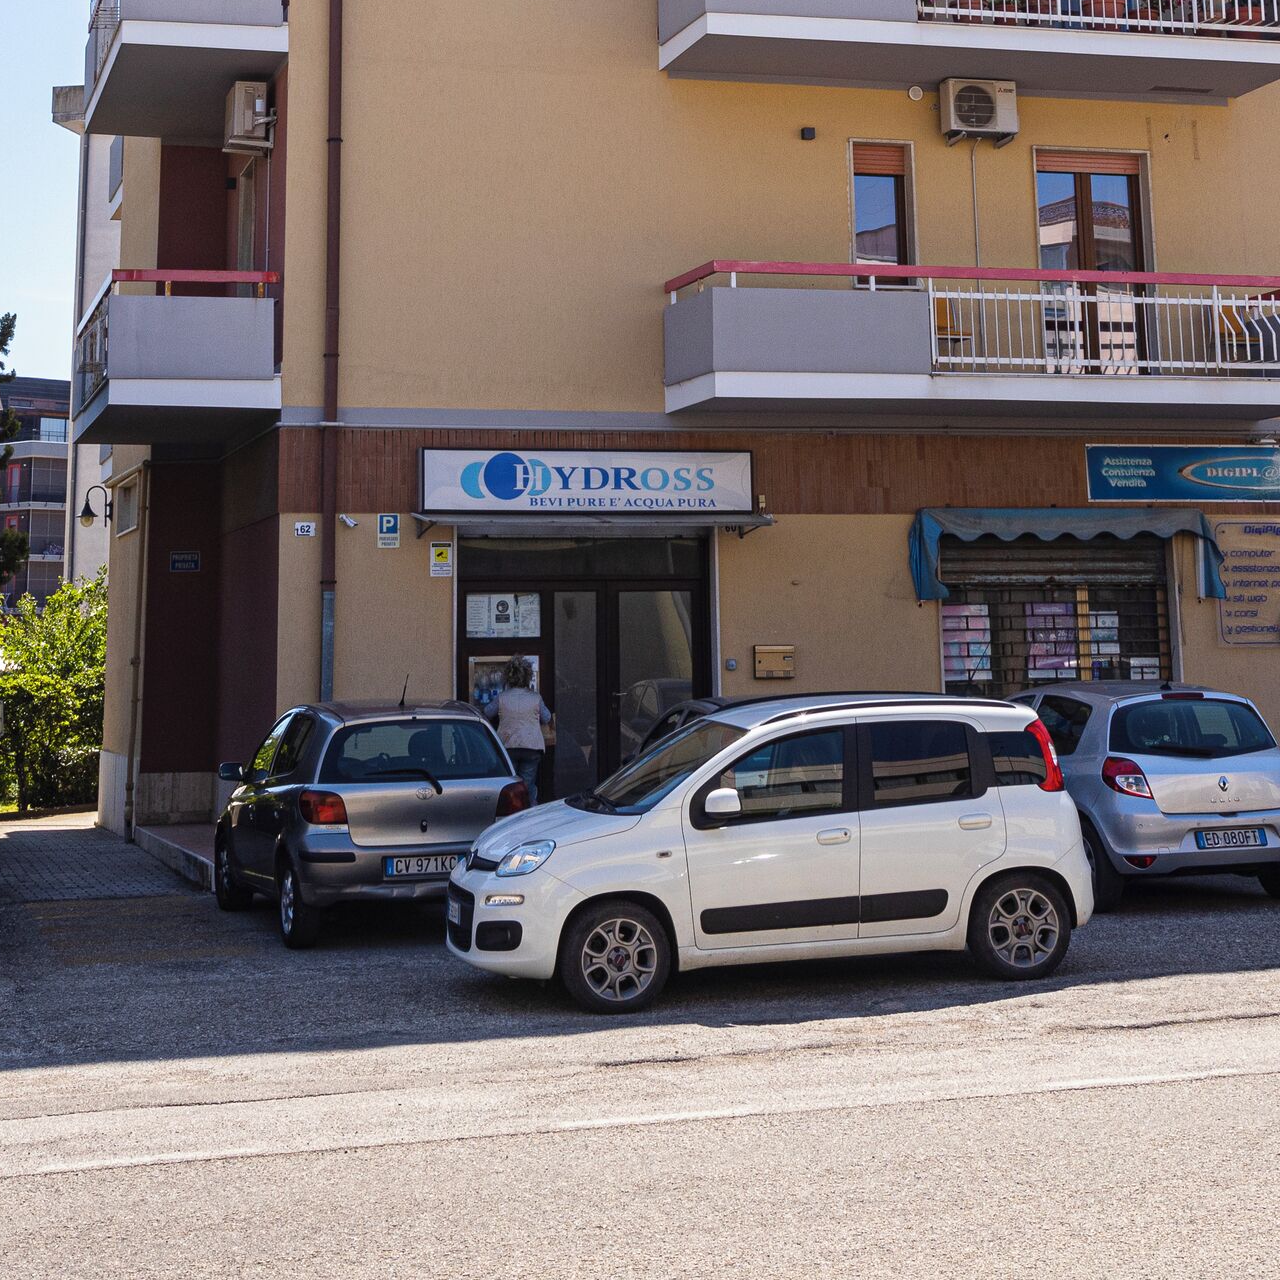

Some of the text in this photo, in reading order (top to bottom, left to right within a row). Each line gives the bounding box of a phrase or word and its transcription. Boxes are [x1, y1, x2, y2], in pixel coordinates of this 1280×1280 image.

[1103, 457, 1153, 466] Assistenza
[1102, 468, 1156, 477] Consulenza
[513, 463, 716, 492] HYDROSS
[1110, 478, 1147, 487] Vendita
[529, 497, 563, 507] BEVI
[567, 497, 607, 508] PURE
[624, 498, 676, 509] ACQUA
[677, 498, 717, 508] PURA
[300, 524, 311, 534] 62
[382, 516, 395, 533] P
[1230, 549, 1276, 558] computer
[1231, 564, 1280, 573] assistenza
[1232, 579, 1269, 587] internet
[1247, 594, 1268, 602] web
[1234, 609, 1258, 617] corsi
